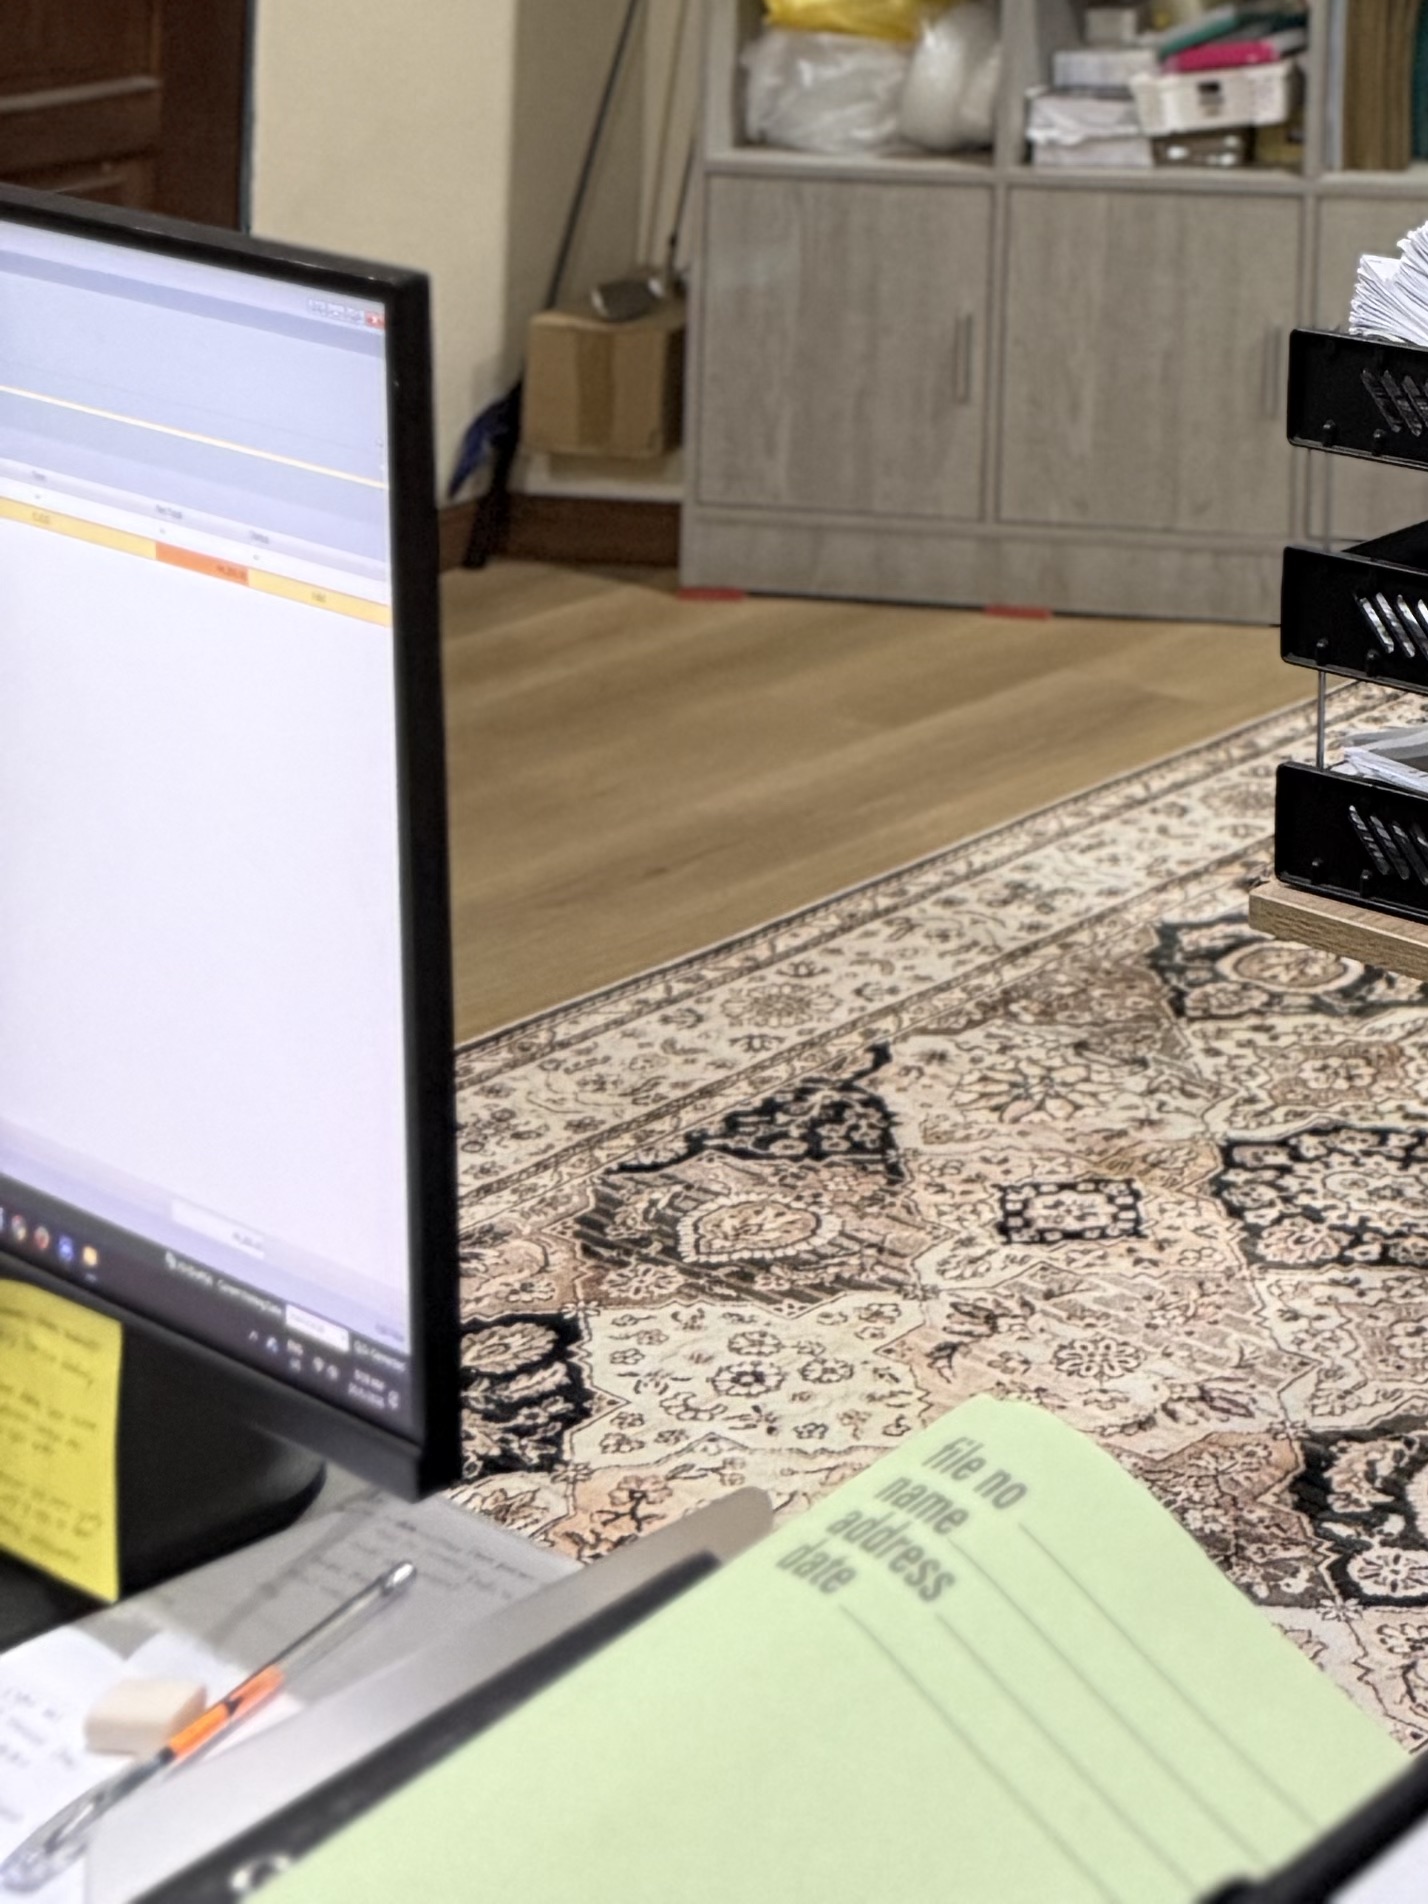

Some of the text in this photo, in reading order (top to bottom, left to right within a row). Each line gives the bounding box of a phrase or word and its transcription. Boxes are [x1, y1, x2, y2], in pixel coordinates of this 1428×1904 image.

[873, 1476, 970, 1535] name
[922, 1436, 1028, 1510] file no
[775, 1538, 857, 1594] date
[825, 1509, 956, 1602] address
